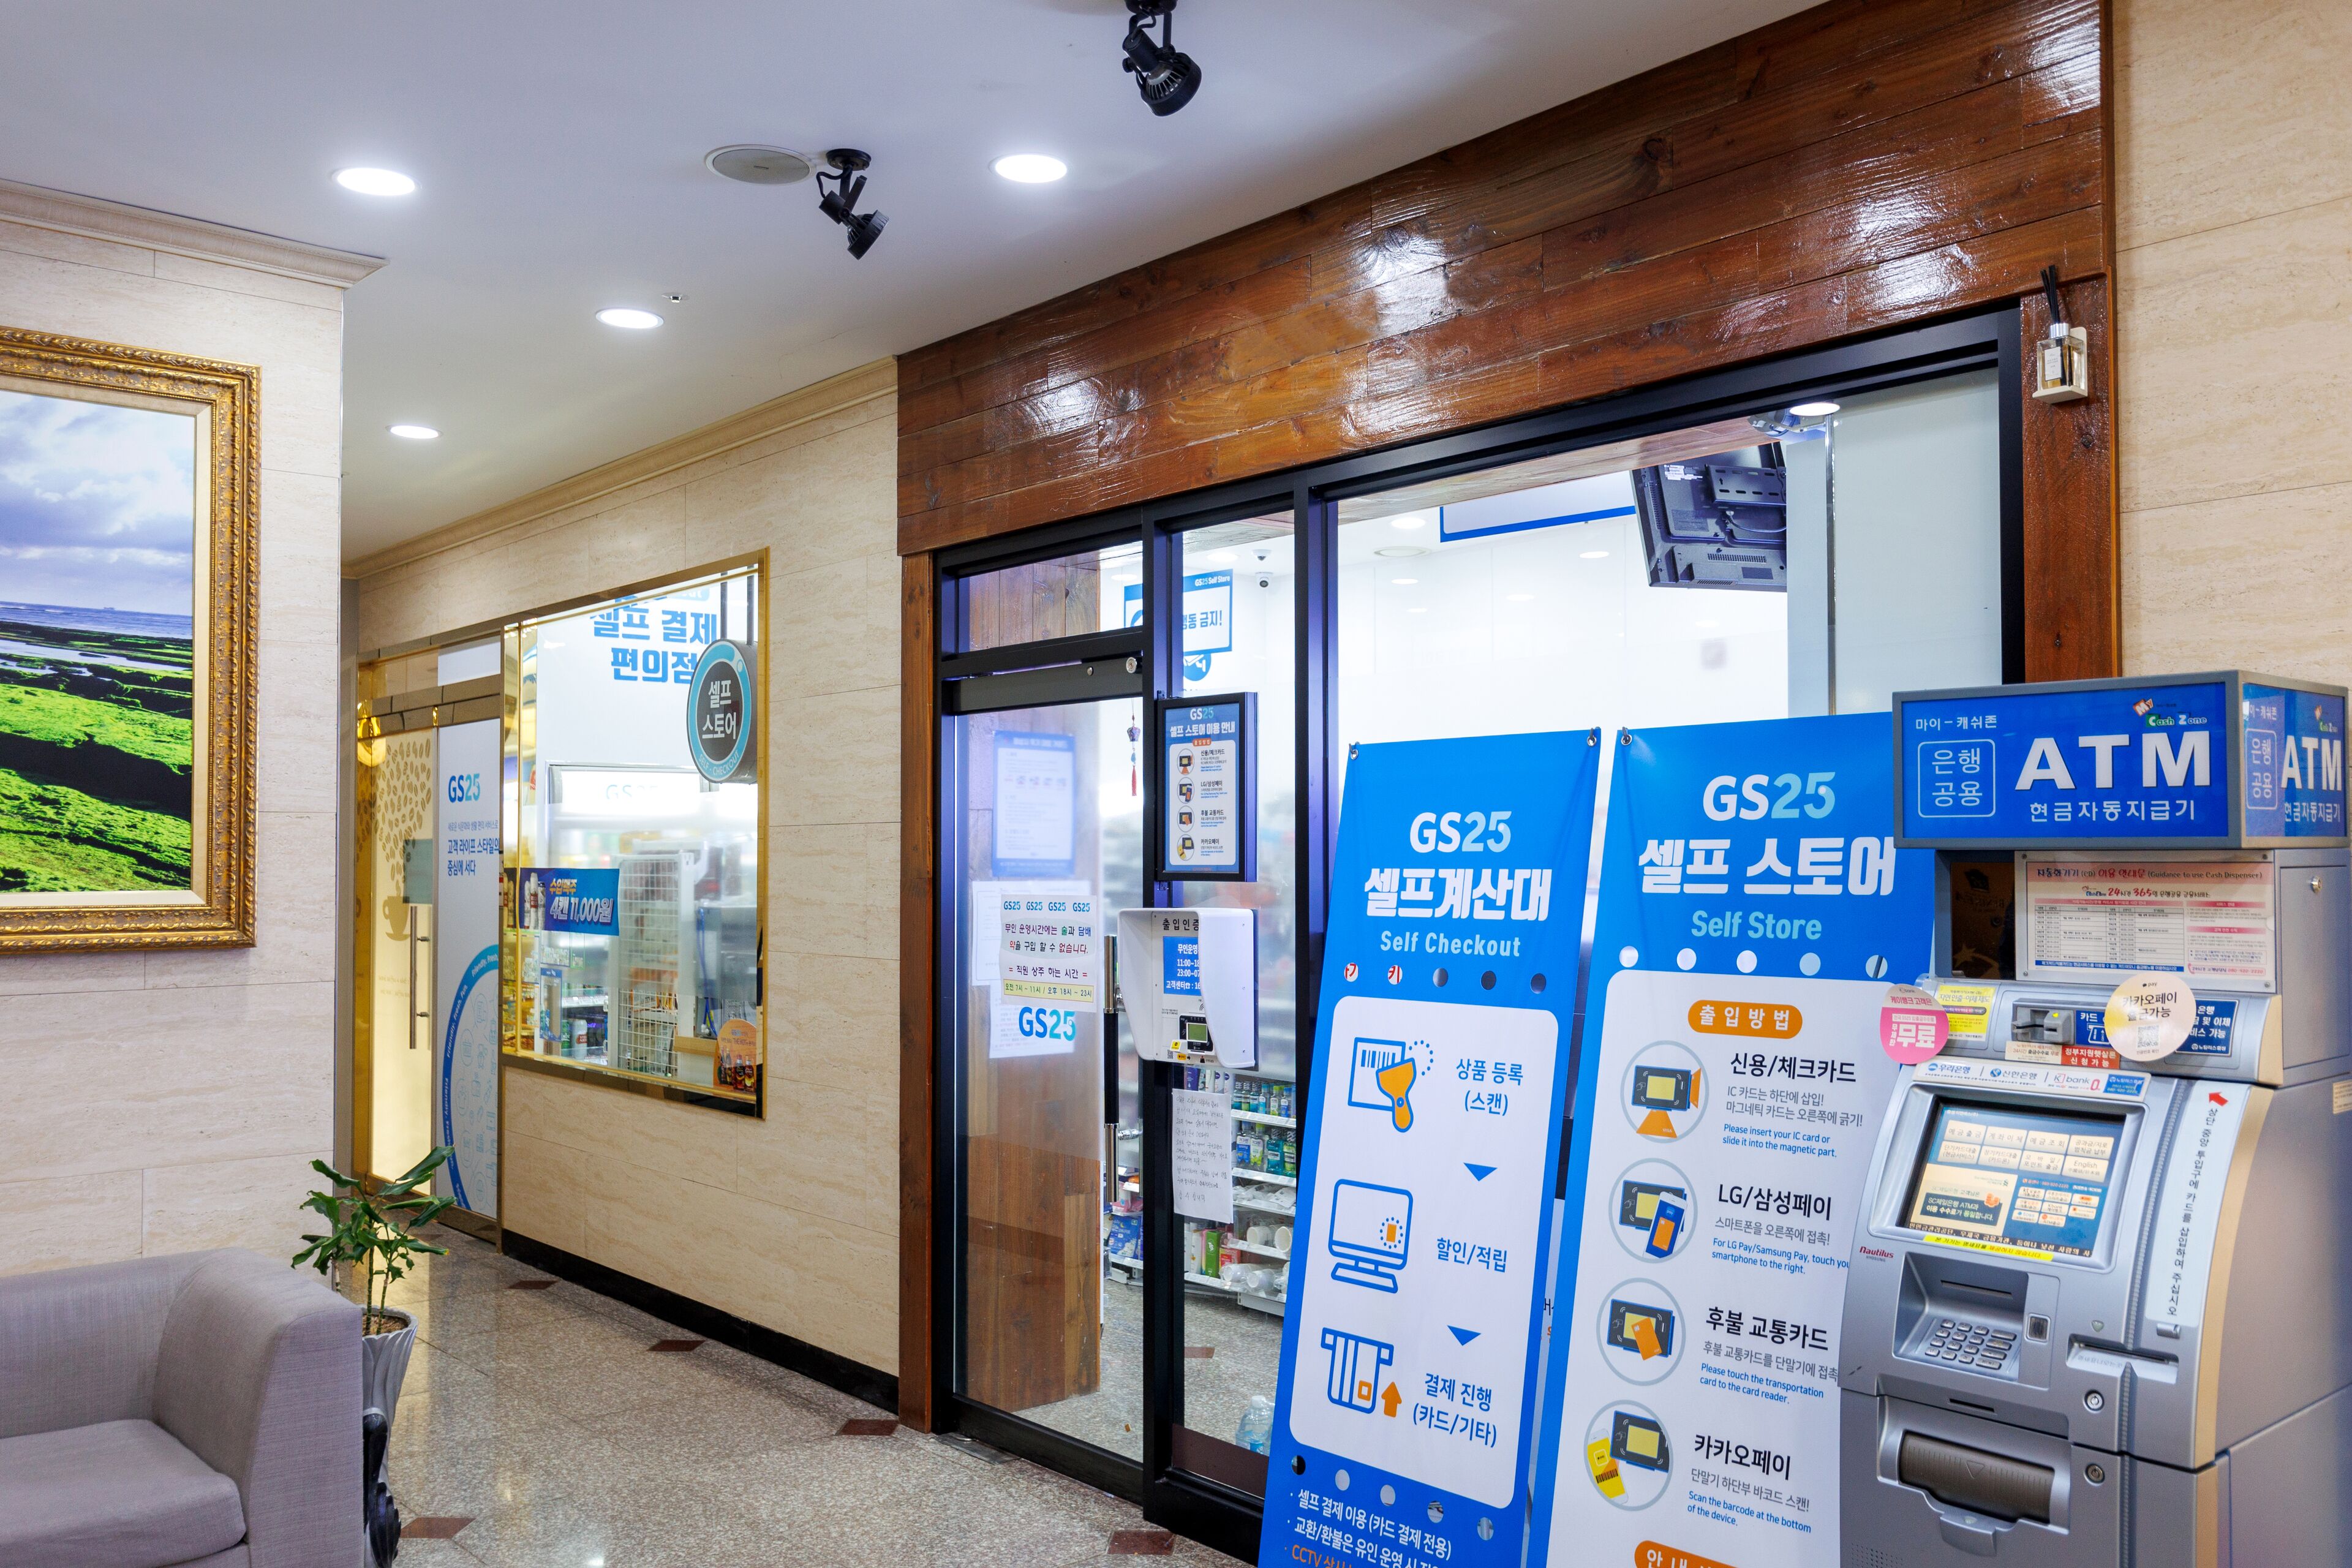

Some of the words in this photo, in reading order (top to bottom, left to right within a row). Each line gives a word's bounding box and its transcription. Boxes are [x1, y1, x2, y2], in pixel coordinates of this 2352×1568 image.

[662, 609, 717, 644] 결제
[1200, 610, 1222, 628] 금지!
[709, 680, 731, 708] 셀프
[703, 712, 736, 739] 스토어
[1190, 707, 1214, 720] GS25
[1915, 716, 1941, 732] 마이
[1956, 714, 1998, 730] 캐쉬존
[1170, 725, 1183, 737] 셀프
[1185, 724, 1205, 736] 스토어
[1221, 722, 1235, 734] 안내
[698, 752, 709, 769] SELF
[712, 749, 740, 775] CHECKOUT
[1931, 747, 1982, 775] 은행
[2015, 731, 2211, 791] ATM
[2251, 737, 2272, 766] 은행
[2281, 734, 2342, 791] ATM
[448, 773, 481, 803] GS25
[1703, 772, 1836, 821] GS25
[1932, 780, 1983, 807] 공용
[2251, 772, 2272, 799] 공용
[2029, 799, 2196, 823] 현금자동지급기
[2284, 801, 2340, 823] 현금자동지급기
[1410, 811, 1512, 853] GS25
[448, 839, 459, 854] 고객
[459, 838, 475, 854] 라이프
[448, 859, 464, 876] 중심에
[465, 860, 476, 876] 서다
[1638, 839, 1731, 894] 셀프
[1744, 837, 1896, 895] 스토어
[2037, 868, 2079, 878] 자동화기기
[2098, 869, 2116, 878] 이용
[2119, 869, 2145, 879] 안내문
[549, 878, 578, 895] 수입맥주
[1364, 868, 1552, 922] 셀프계산대
[2108, 888, 2132, 897] 24시간
[2133, 888, 2158, 897] 365일
[549, 897, 568, 921] 4캔
[570, 897, 614, 924] 11,000원
[1003, 901, 1021, 910] GS25
[1026, 902, 1043, 911] GS25
[1049, 902, 1066, 911] GS25
[1073, 903, 1090, 912] GS25
[1005, 924, 1017, 933] 무인
[1019, 924, 1057, 935] 운영시간에는
[1061, 926, 1075, 936] 술과
[1692, 910, 1742, 938] Self
[1747, 911, 1822, 940] Store
[1024, 941, 1036, 951] 구입
[1040, 942, 1046, 952] 할
[1049, 943, 1055, 952] 수
[1381, 930, 1419, 952] Self
[1425, 932, 1520, 957] Checkout
[1017, 965, 1028, 976] 직원
[1031, 967, 1044, 976] 상주
[1048, 967, 1061, 978] 하는
[1065, 968, 1079, 979] 시간
[1019, 1006, 1077, 1041] GS25
[2080, 1012, 2098, 1022] 카드
[2198, 1006, 2215, 1015] 은행
[2214, 1017, 2231, 1027] 이체
[1897, 1024, 1935, 1049] 무료
[2209, 1029, 2226, 1039] 가능
[1456, 1059, 1487, 1082] 상품
[1492, 1062, 1524, 1086] 등록
[1730, 1052, 1856, 1083] 신용/체크카드
[2003, 1071, 2038, 1080] 신한은행
[1464, 1090, 1509, 1117] (스캔)
[1728, 1086, 1737, 1096] IC
[1739, 1087, 1767, 1101] 카드는
[1770, 1089, 1799, 1104] 하단에
[1801, 1092, 1824, 1106] 삽입!
[1726, 1101, 1763, 1117] 마그네틱
[1766, 1105, 1795, 1120] 카드는
[1796, 1108, 1838, 1125] 오른쪽에
[2207, 1108, 2218, 1126] 상단
[1724, 1123, 1748, 1134] Please
[1749, 1126, 1772, 1137] insert
[1774, 1130, 1792, 1139] your
[1793, 1131, 1801, 1140] IC
[1802, 1133, 1820, 1142] card
[2200, 1128, 2212, 1147] 중앙
[1722, 1136, 1740, 1145] slide
[1749, 1139, 1763, 1148] into
[1765, 1140, 1777, 1150] the
[1780, 1142, 1816, 1155] magnetic
[1818, 1148, 1837, 1158] part.
[2073, 1161, 2098, 1169] English
[2189, 1150, 2206, 1190] 투입구에
[1718, 1184, 1832, 1221] LG/삼성페이
[2183, 1192, 2196, 1223] 카드를
[1715, 1217, 1763, 1236] 스마트폰을
[1765, 1224, 1804, 1242] 오른쪽에
[1806, 1230, 1831, 1246] 접촉!
[1436, 1238, 1507, 1273] 할인/적립
[2174, 1227, 2190, 1270] 삽입하여
[2167, 1272, 2182, 1317] 주십시오
[1706, 1306, 1744, 1336] 후불
[1749, 1316, 1828, 1351] 교통카드
[1703, 1340, 1722, 1357] 후불
[1724, 1346, 1773, 1368] 교통카드를
[1776, 1356, 1815, 1378] 단말기에
[1425, 1373, 1455, 1402] 결제
[1460, 1384, 1493, 1412] 진행
[1413, 1403, 1497, 1448] (카드/기타)
[1694, 1434, 1791, 1481] 카카오페이
[1692, 1468, 1719, 1488] 단말기
[1722, 1476, 1751, 1496] 하단부
[1753, 1485, 1783, 1504] 바코드
[1785, 1494, 1810, 1513] 스캔!
[1298, 1488, 1319, 1510] 셀프
[1322, 1497, 1343, 1521] 결제
[1345, 1506, 1366, 1529] 이용
[1398, 1523, 1422, 1550] 결제
[1294, 1517, 1354, 1554] 교환/환불은
[1355, 1538, 1378, 1563] 유인
[1292, 1544, 1322, 1568] CCTV
